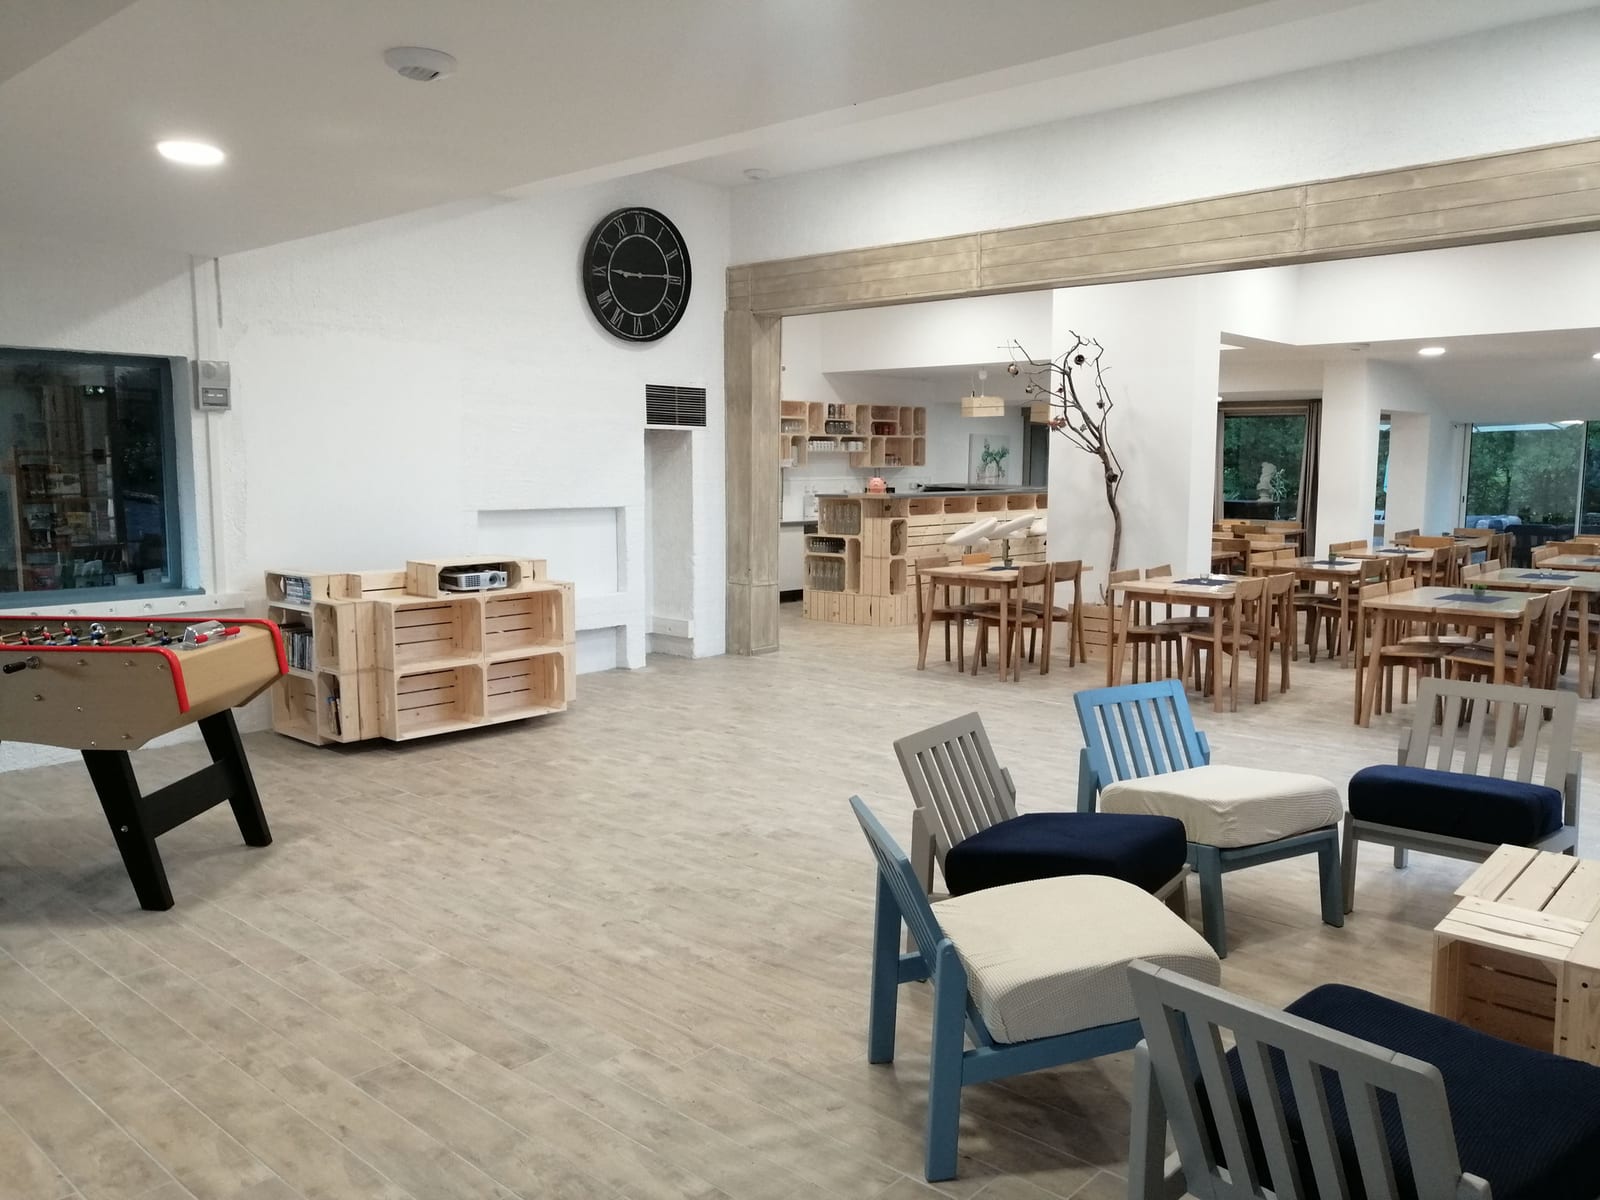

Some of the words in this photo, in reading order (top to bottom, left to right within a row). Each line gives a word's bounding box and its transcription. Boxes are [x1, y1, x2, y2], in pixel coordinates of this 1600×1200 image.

[599, 237, 613, 253] X
[592, 265, 606, 276] IX
[633, 316, 643, 335] VI
